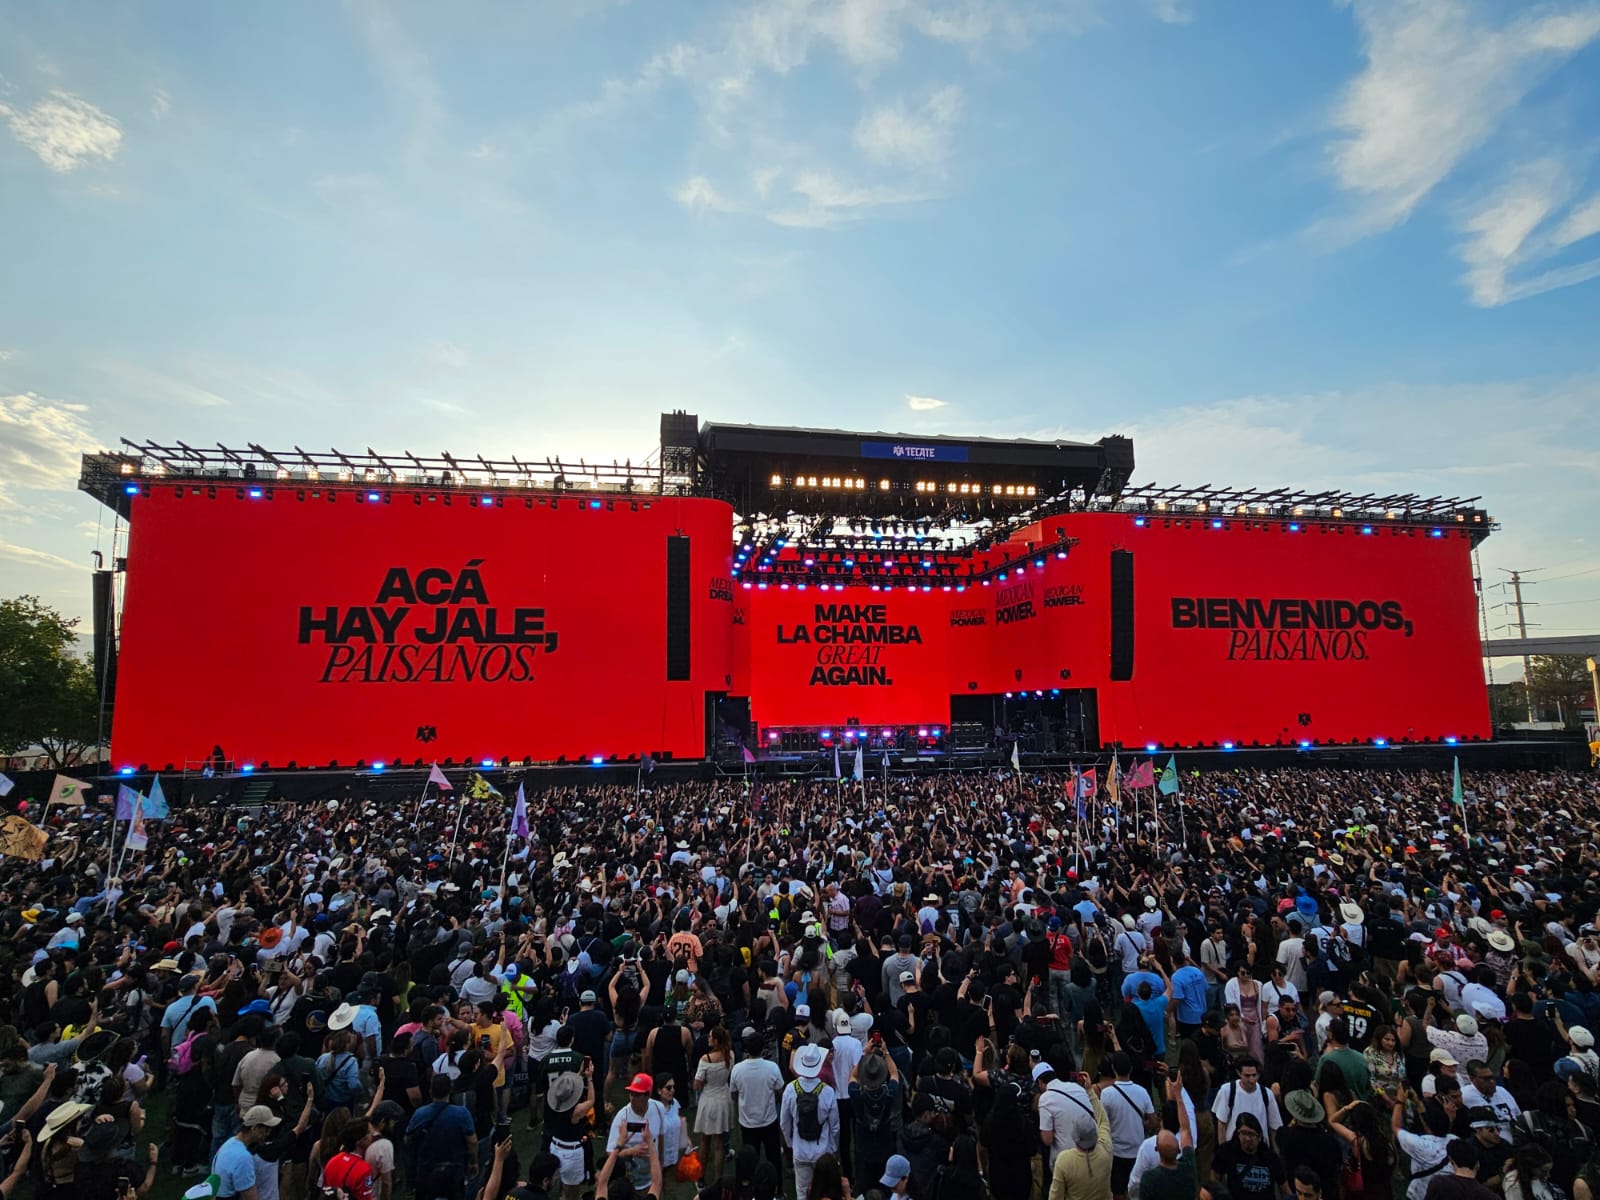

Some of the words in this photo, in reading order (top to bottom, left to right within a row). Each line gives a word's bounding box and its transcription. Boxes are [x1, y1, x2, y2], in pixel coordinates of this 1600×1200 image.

[905, 446, 936, 458] TECATE
[375, 558, 489, 605] ACÁ
[996, 580, 1035, 608] MEXICAN
[1044, 595, 1086, 608] POWER.
[814, 604, 887, 624] MAKE
[996, 600, 1037, 626] POWER.
[1171, 597, 1414, 638] BIENVENIDOS,
[298, 606, 411, 644] HAY
[414, 606, 559, 654] JALE,
[777, 624, 811, 644] LA
[813, 624, 923, 645] CHAMBA
[817, 644, 884, 665] GREAT
[1226, 629, 1370, 662] PAISANOS.
[317, 643, 537, 684] PAISANOS.
[809, 665, 893, 686] AGAIN.
[673, 942, 691, 960] 26
[1347, 1014, 1368, 1039] 19
[549, 1056, 572, 1065] BETO
